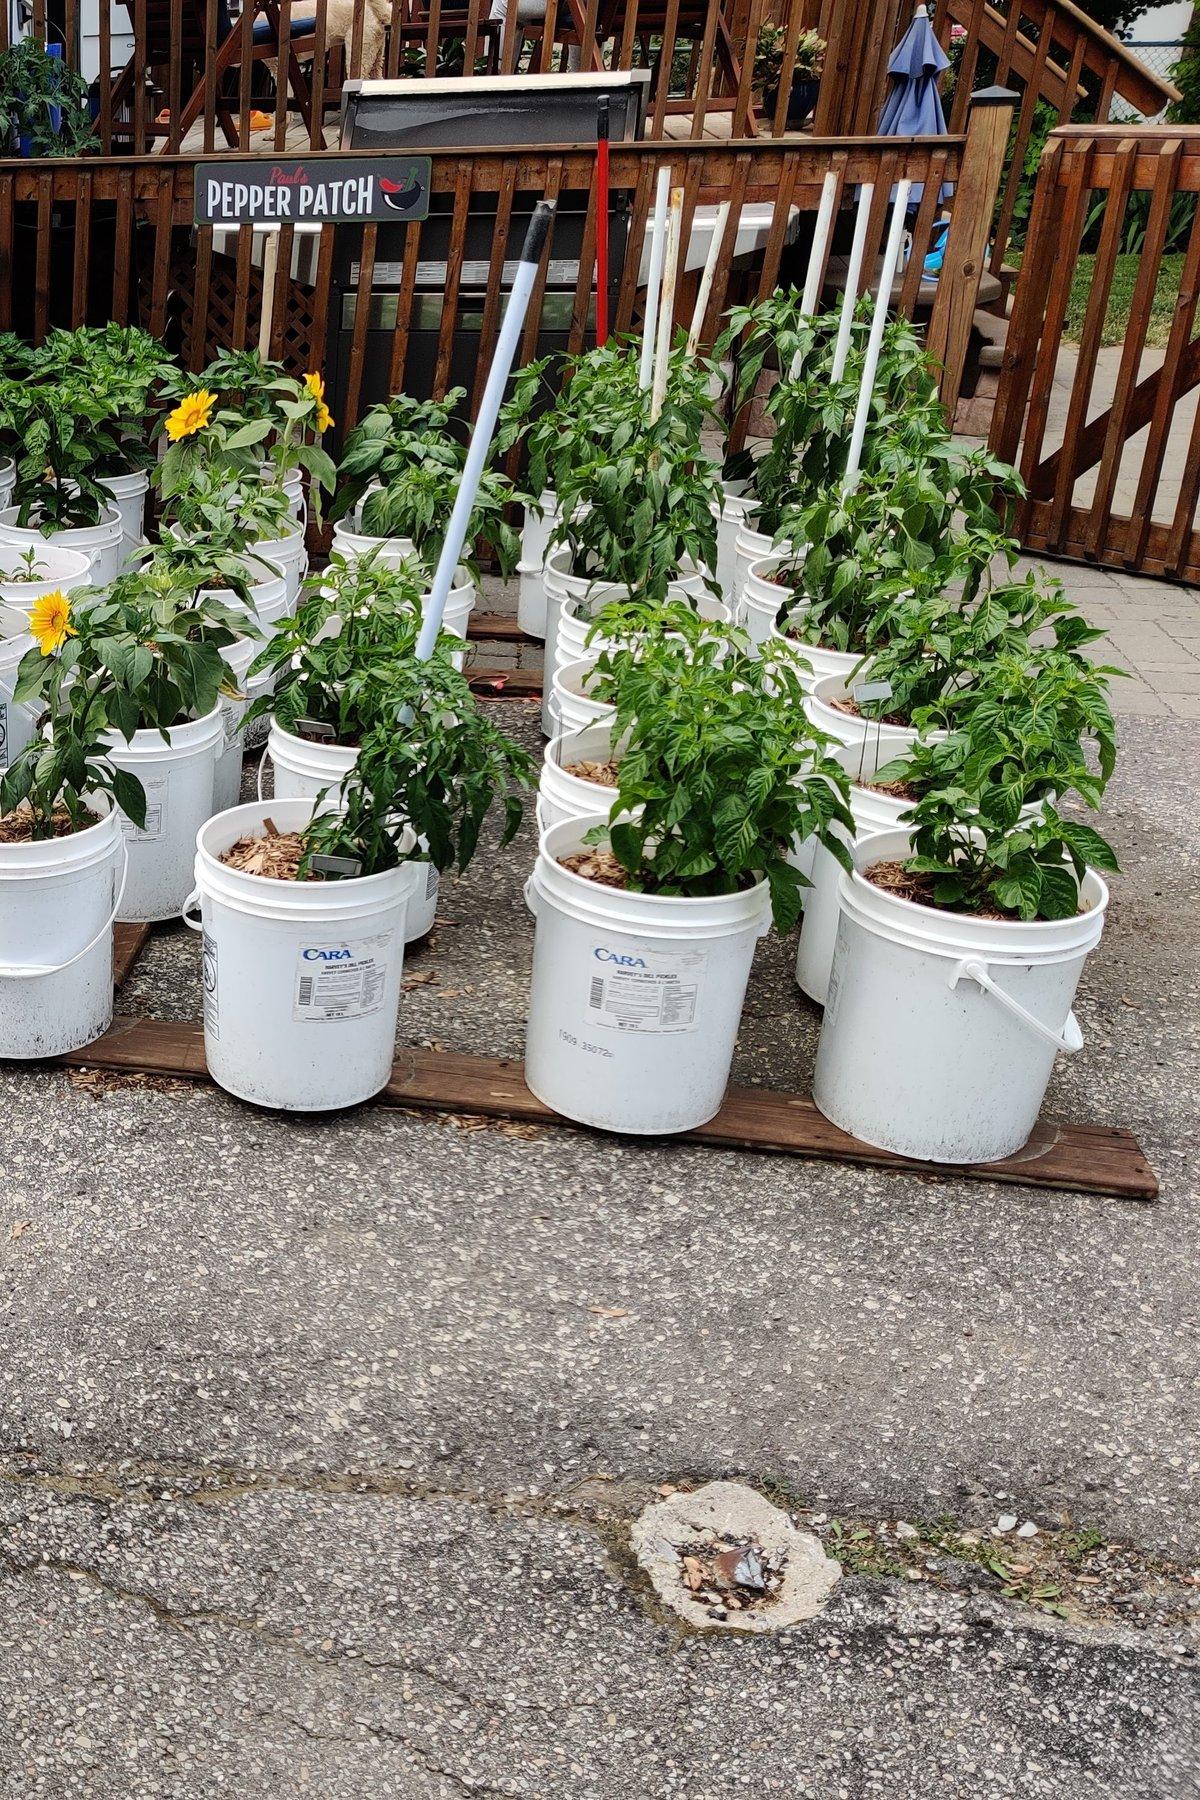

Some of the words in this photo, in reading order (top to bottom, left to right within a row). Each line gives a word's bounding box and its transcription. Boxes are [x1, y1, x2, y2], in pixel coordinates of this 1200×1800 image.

[269, 166, 309, 185] Paul's
[207, 179, 291, 218] PEPPER
[299, 175, 374, 216] PATCH
[303, 948, 353, 961] CARA
[594, 948, 649, 968] CARA
